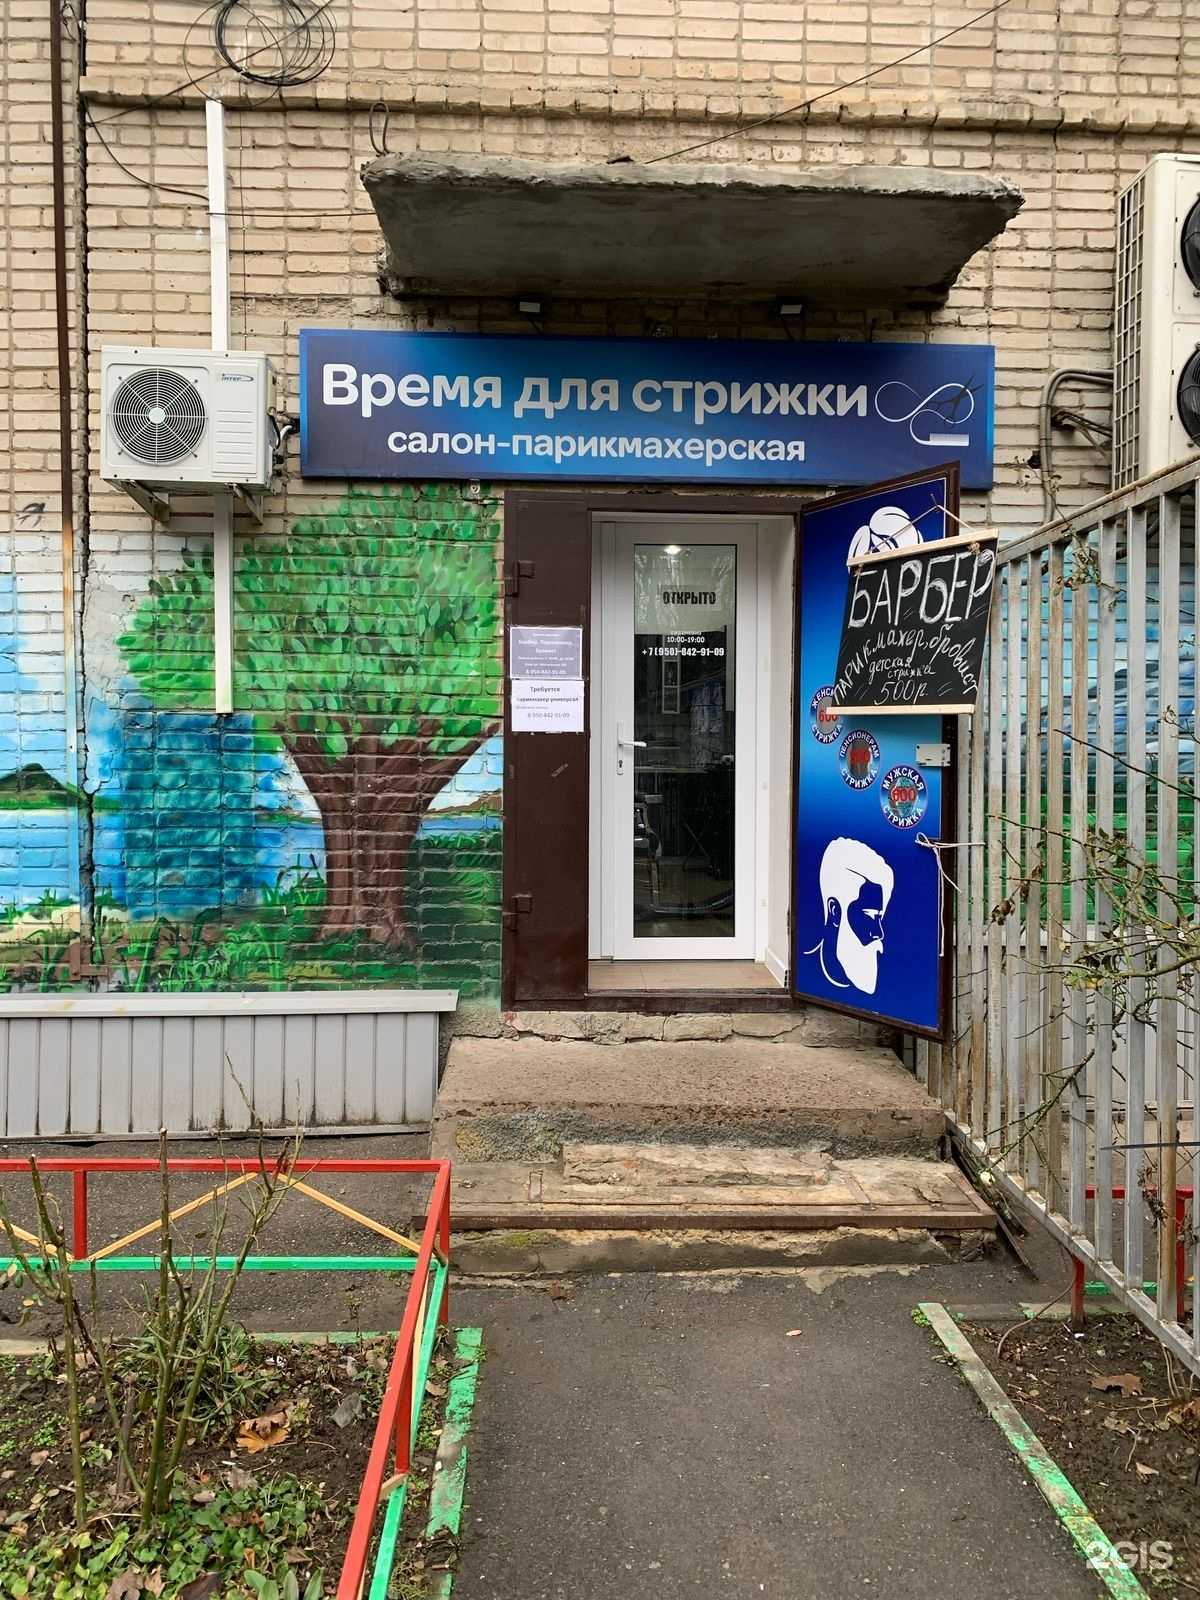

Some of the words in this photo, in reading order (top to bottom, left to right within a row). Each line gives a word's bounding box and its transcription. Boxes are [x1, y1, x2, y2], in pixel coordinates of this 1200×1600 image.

[323, 363, 502, 418] Время
[513, 378, 619, 419] для
[632, 379, 868, 425] стрижки
[387, 431, 806, 467] салон-парикмахерская
[663, 591, 717, 605] ОТКРЫТО
[848, 549, 996, 629] БАРБЕР
[869, 656, 913, 684] детская
[811, 687, 835, 709] ЖЕНС
[812, 724, 842, 743] СТРИЖКА
[840, 731, 880, 758] ПЕНСИОНЕРАМ
[841, 768, 878, 788] СТРИЖКА
[882, 768, 925, 790] МУЖСКАЯ
[883, 805, 924, 827] СТРИЖКА
